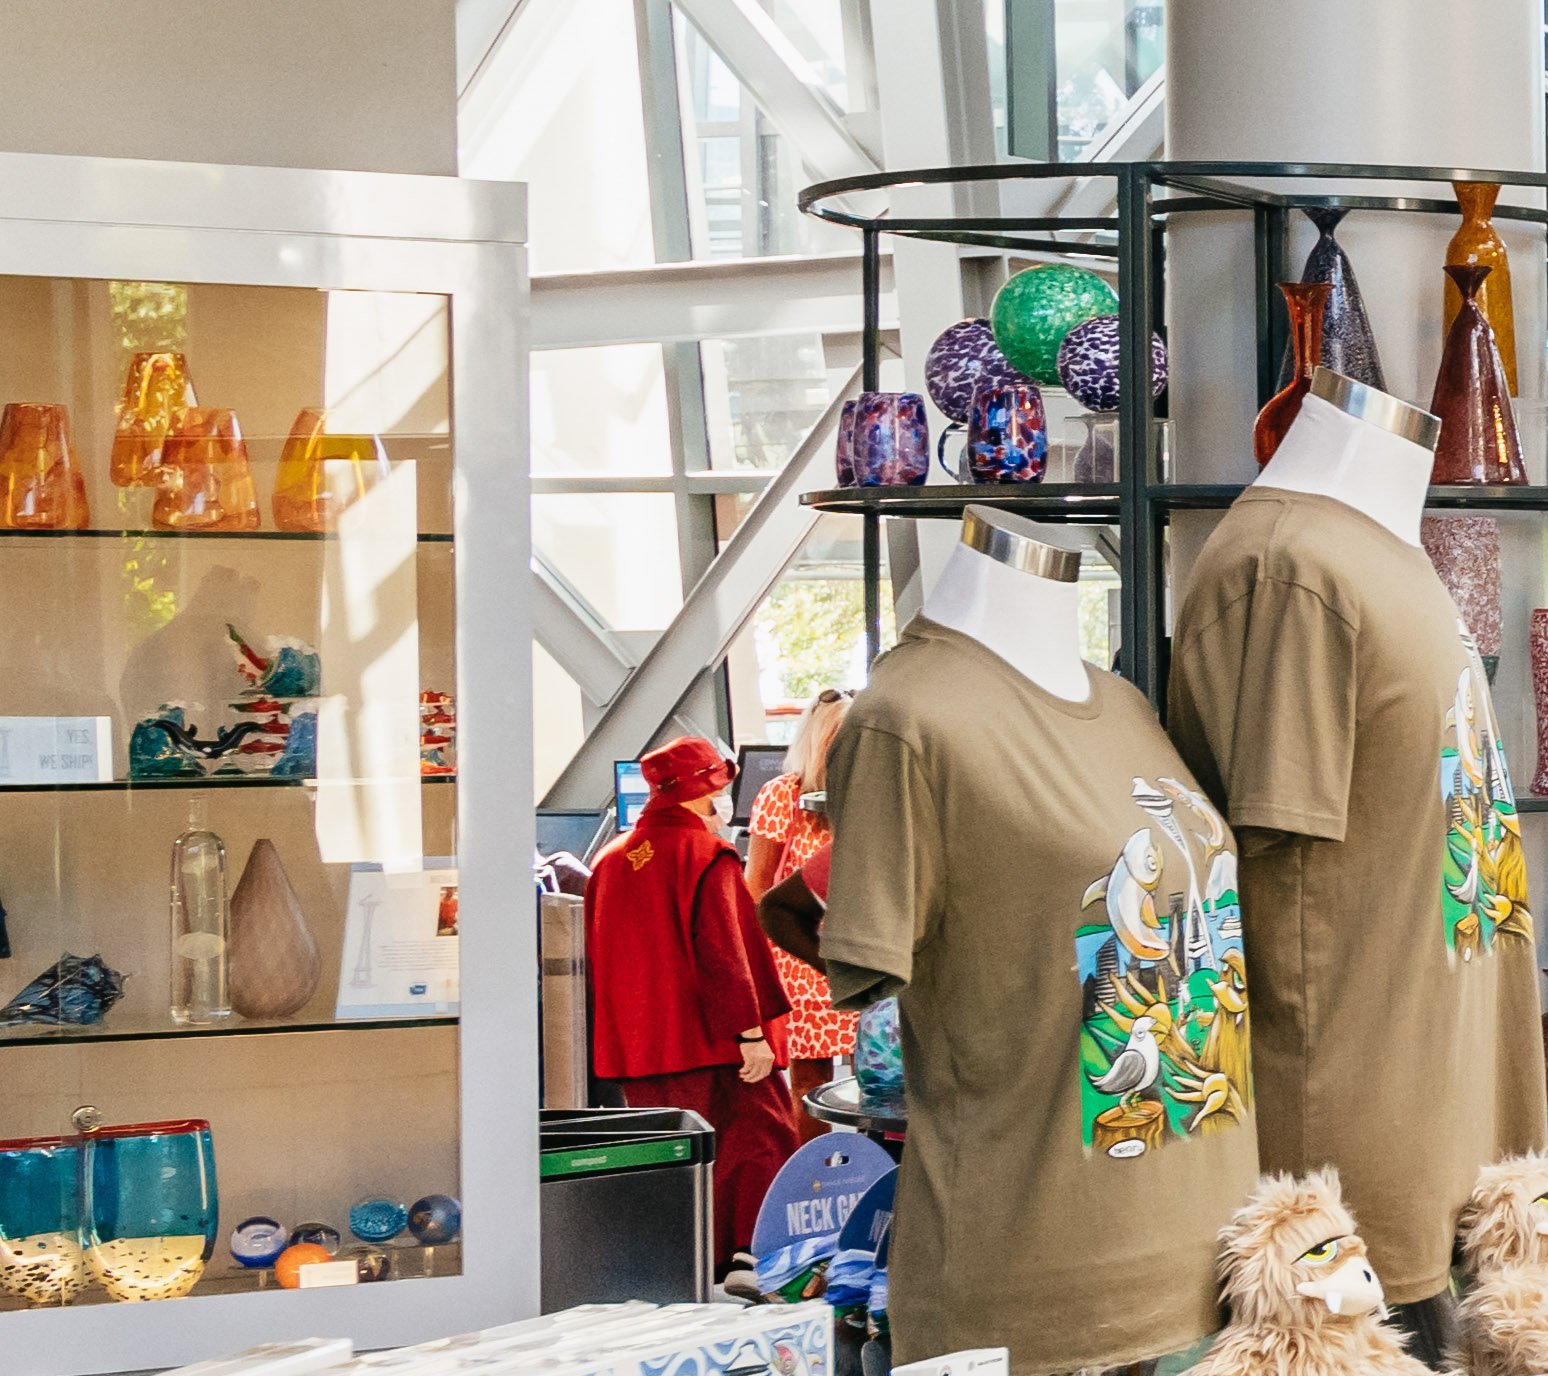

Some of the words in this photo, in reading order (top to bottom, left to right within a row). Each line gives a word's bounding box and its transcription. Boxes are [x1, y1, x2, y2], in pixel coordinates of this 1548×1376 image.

[66, 728, 90, 744] YES
[39, 754, 58, 770] WE
[786, 1196, 835, 1237] NECK
